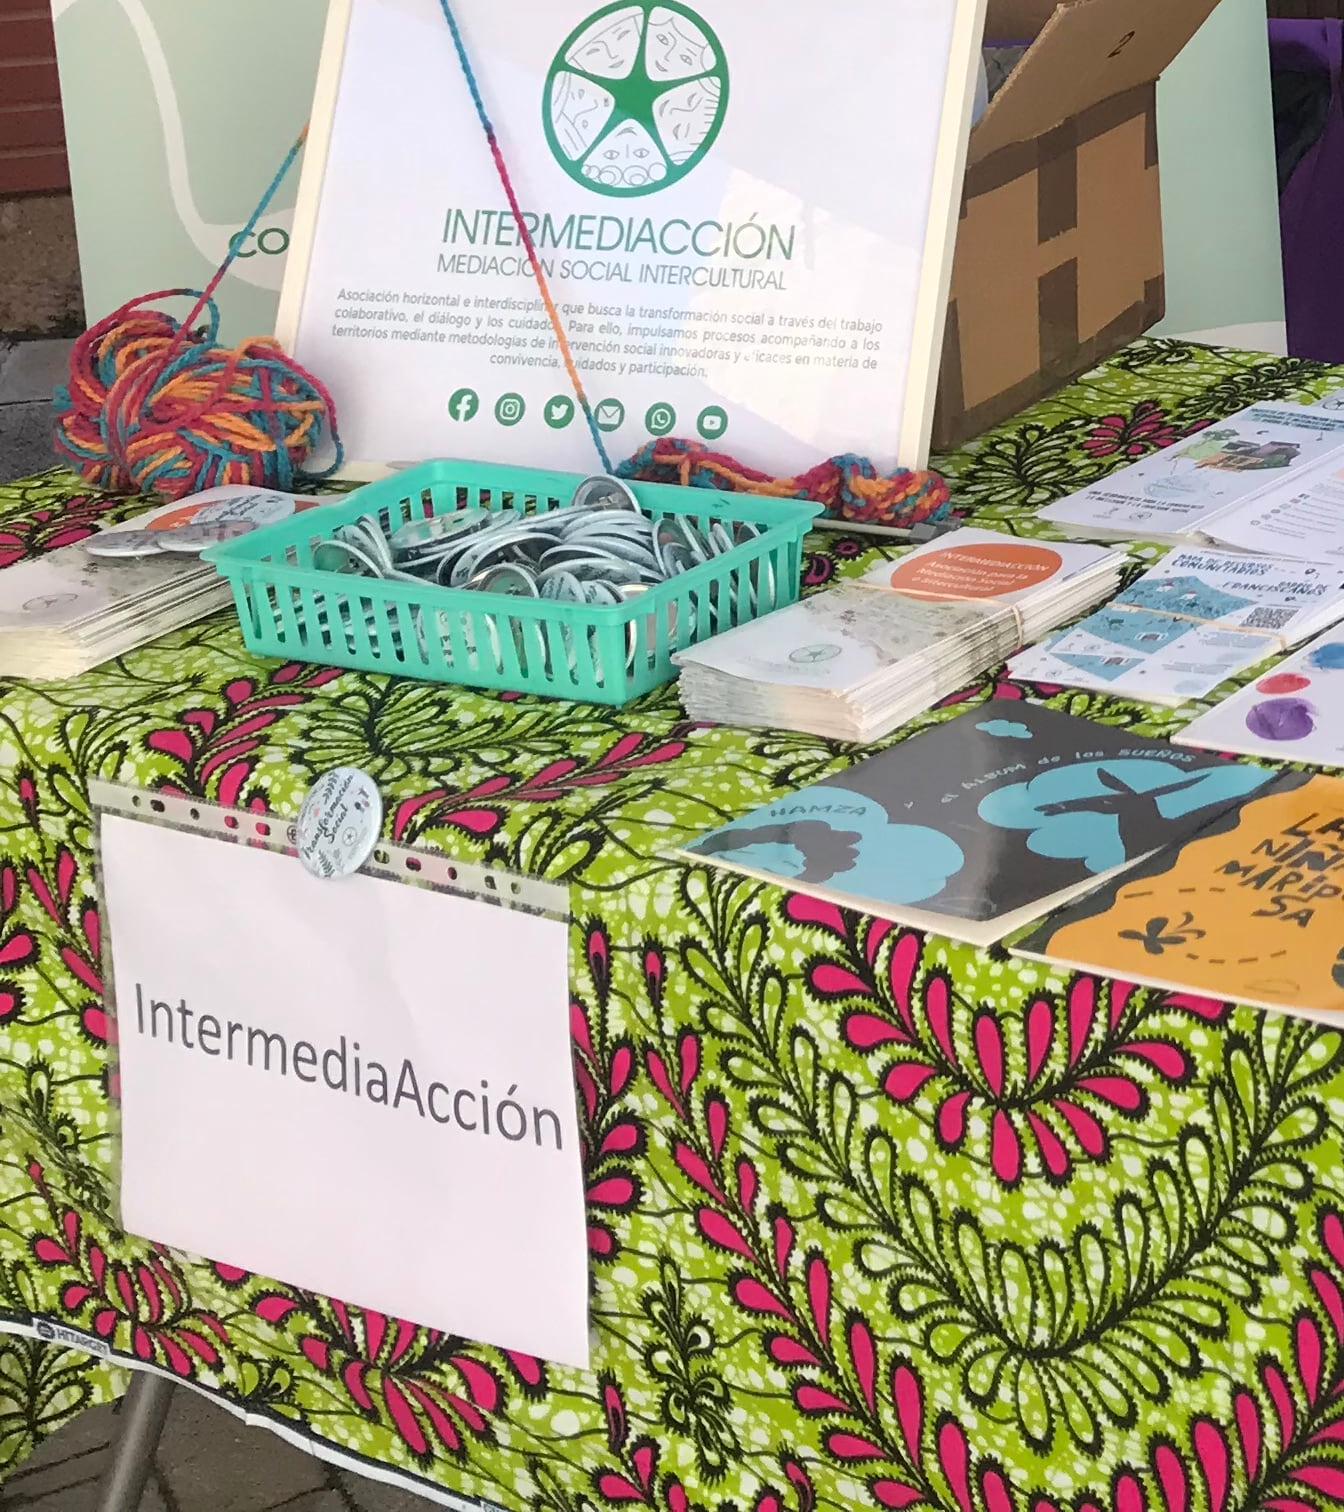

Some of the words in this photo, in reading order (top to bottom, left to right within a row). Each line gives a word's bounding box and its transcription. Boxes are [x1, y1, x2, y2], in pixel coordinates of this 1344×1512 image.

[441, 207, 796, 261] INTERMEDIACCIÓN
[559, 258, 633, 283] SOCIAL
[638, 264, 788, 291] INTERCULTURAL
[334, 305, 409, 324] colaborativo,
[413, 310, 425, 324] el
[427, 310, 472, 330] diálogo
[475, 317, 483, 330] y
[487, 315, 504, 329] los
[568, 319, 595, 334] Para
[598, 321, 622, 337] ello,
[627, 325, 698, 343] impulsamos
[703, 331, 756, 348] procesos
[760, 333, 847, 352] acompañando
[850, 339, 858, 350] a
[862, 337, 880, 352] los
[337, 288, 400, 304] Asociación
[402, 291, 460, 308] horizontal
[463, 297, 471, 308] e
[473, 295, 559, 313] interdisciplinr
[562, 302, 585, 318] que
[587, 301, 622, 318] busca
[625, 303, 636, 318] la
[638, 306, 728, 325] transformación
[730, 311, 766, 327] social
[768, 317, 775, 328] a
[779, 314, 815, 331] través
[840, 318, 884, 336] trabajo
[331, 324, 388, 340] territorios
[391, 329, 446, 344] mediante
[448, 332, 528, 351] metodologías
[530, 336, 546, 350] de
[548, 338, 621, 355] inervención
[623, 342, 657, 357] social
[659, 344, 731, 362] innovadoras
[732, 349, 740, 363] y
[794, 354, 811, 367] en
[813, 354, 860, 369] materia
[862, 357, 878, 370] de
[489, 353, 561, 370] convivencia,
[564, 357, 618, 373] uidados
[619, 361, 627, 374] y
[628, 360, 709, 379] participación.
[769, 802, 867, 818] HAMZA
[134, 982, 564, 1150] IntermediaAcción
